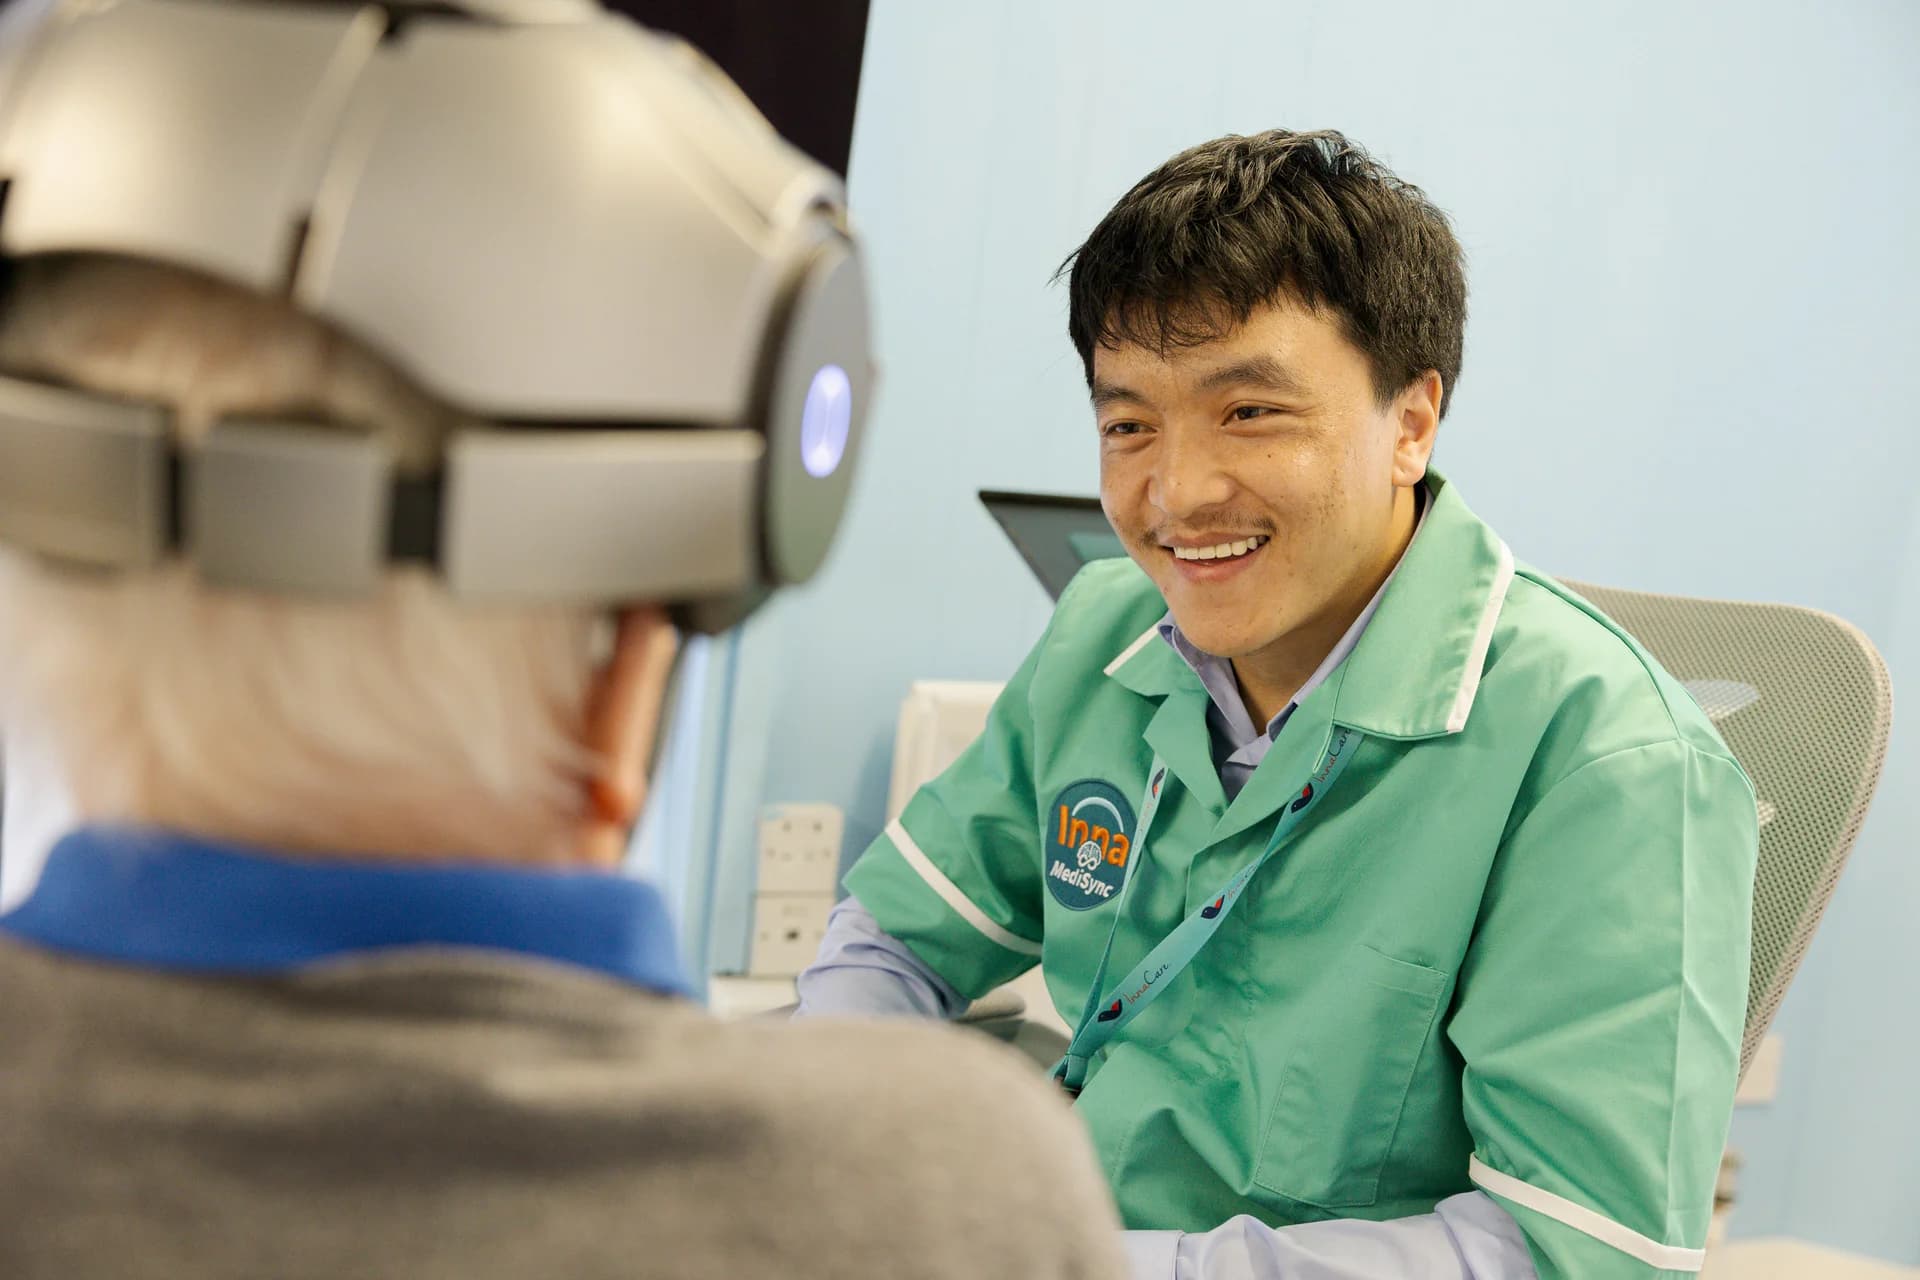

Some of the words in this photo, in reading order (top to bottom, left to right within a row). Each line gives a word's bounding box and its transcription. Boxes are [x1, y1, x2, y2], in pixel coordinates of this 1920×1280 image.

[1057, 804, 1130, 868] Inna
[1049, 860, 1115, 898] MediSync
[1122, 963, 1169, 1005] InnaCare
